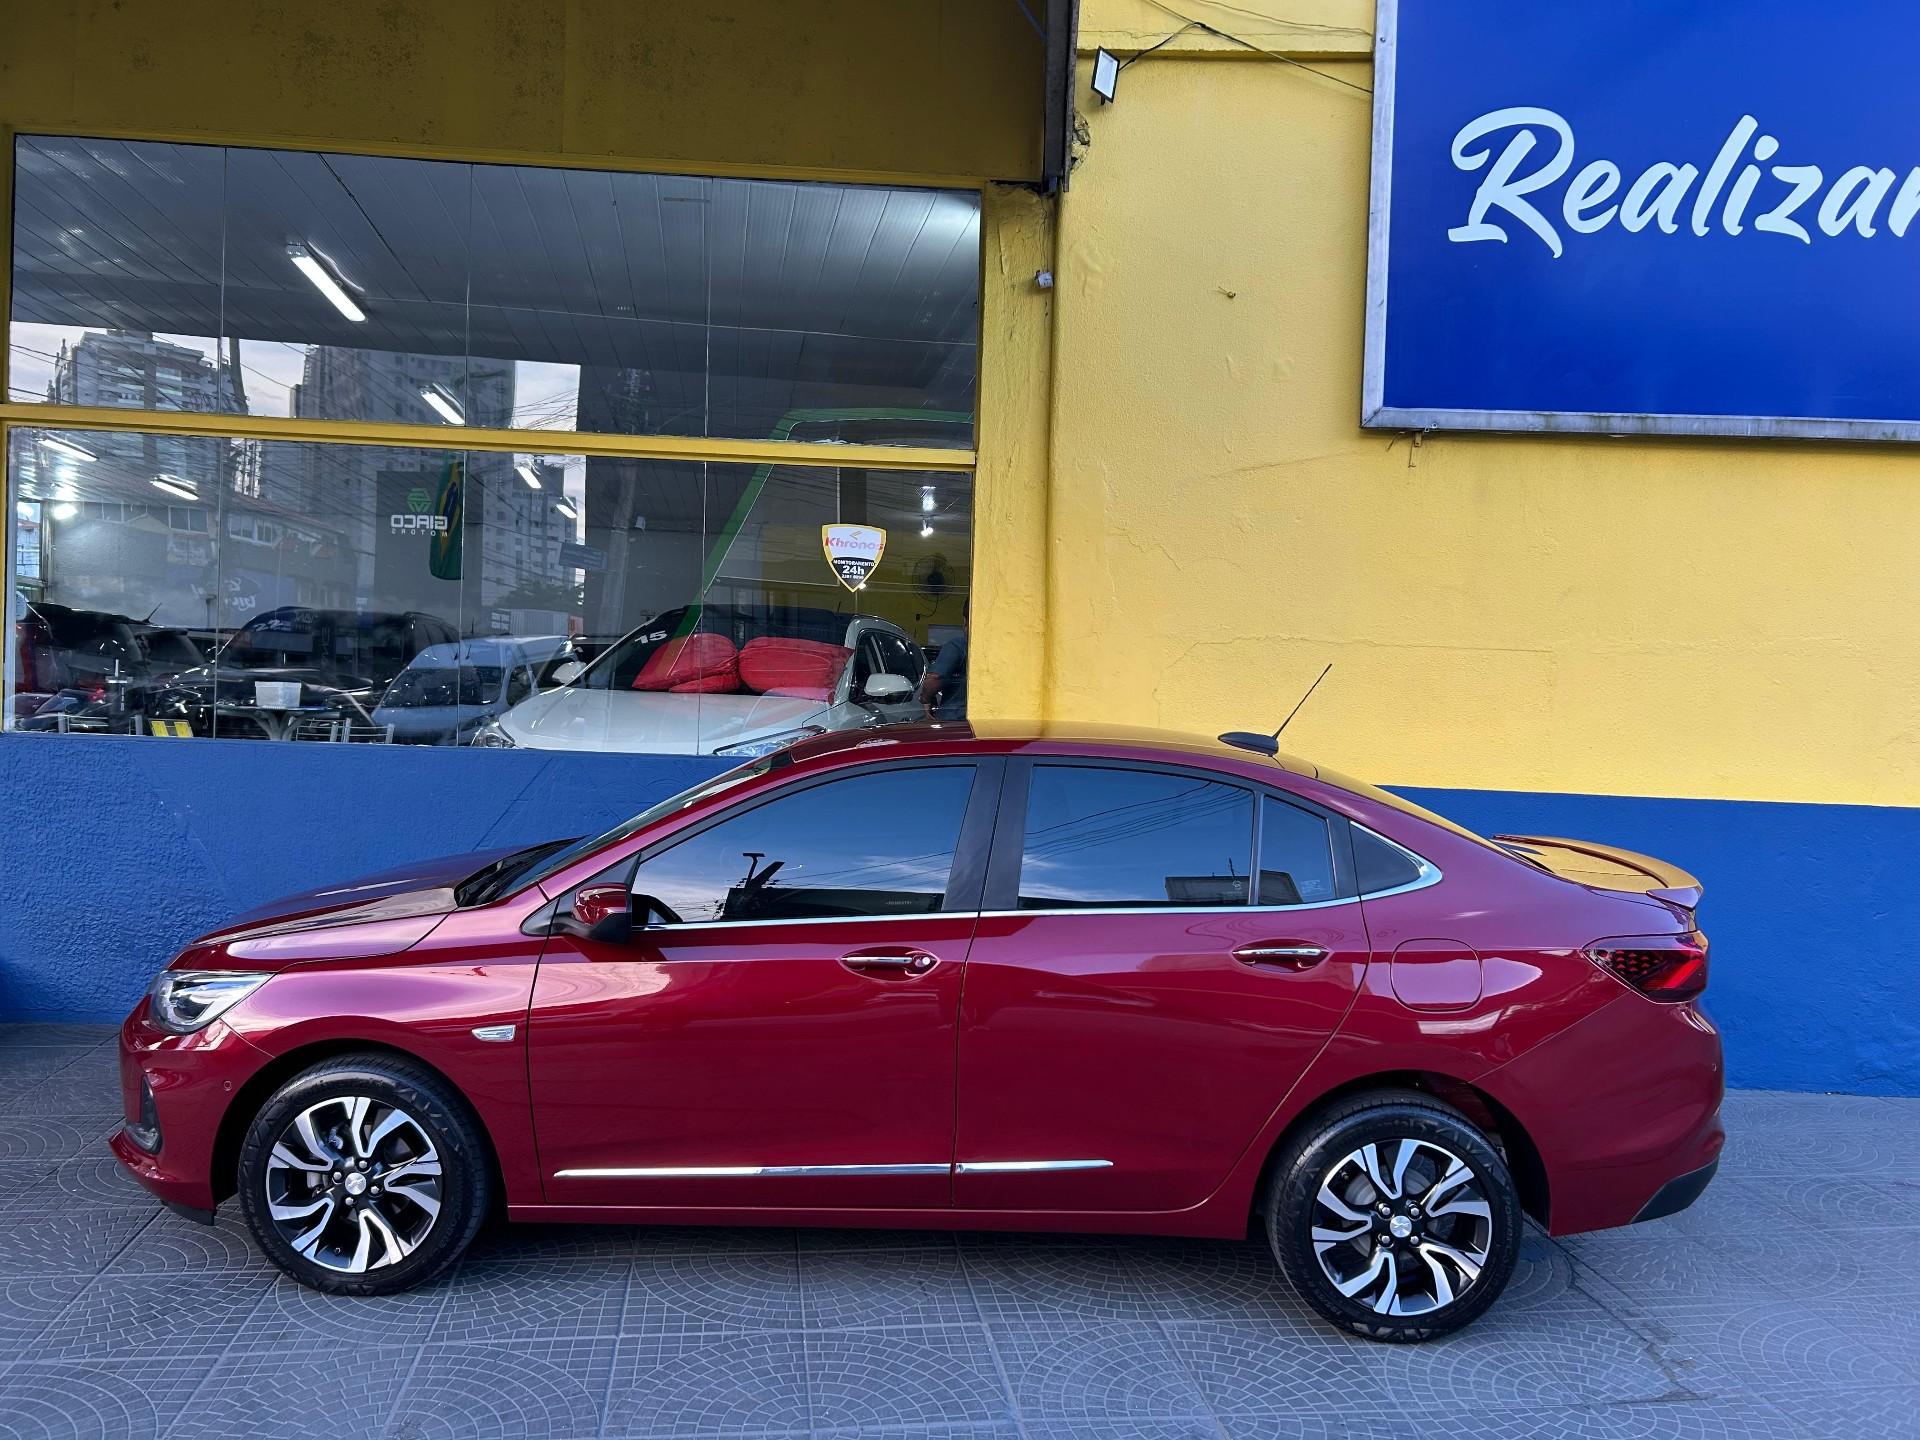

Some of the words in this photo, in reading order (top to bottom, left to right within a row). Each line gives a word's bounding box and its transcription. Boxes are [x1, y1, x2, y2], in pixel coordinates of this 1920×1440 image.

[824, 537, 884, 550] Khronos
[842, 566, 865, 575] 24h
[634, 630, 668, 644] 15
